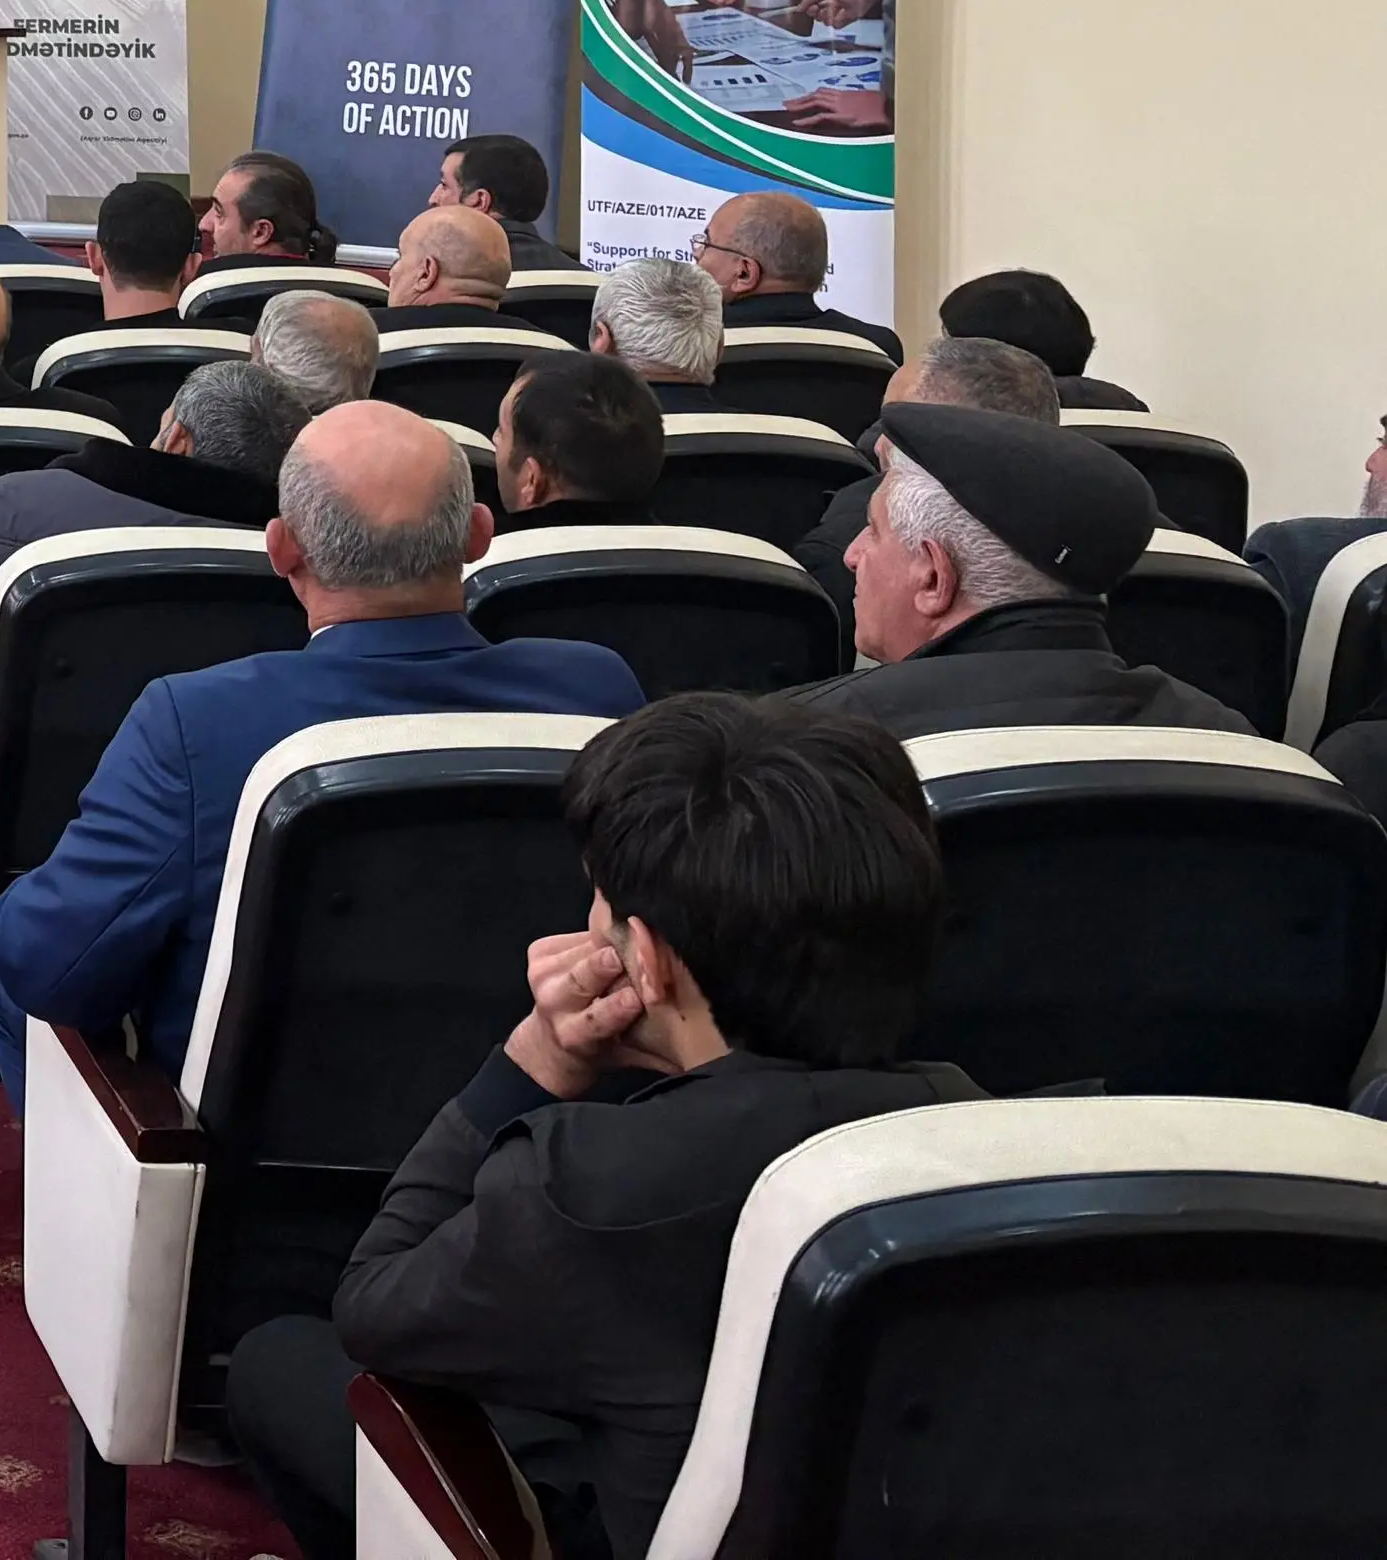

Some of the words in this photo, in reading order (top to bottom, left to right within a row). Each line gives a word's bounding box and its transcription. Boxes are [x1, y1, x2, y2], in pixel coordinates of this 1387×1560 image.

[13, 14, 120, 35] FERMERİN
[7, 38, 156, 58] DMƏTİNDƏYİK
[346, 60, 396, 94] 365
[404, 63, 473, 98] DAYS
[343, 102, 375, 134] OF
[378, 104, 469, 140] ACTION
[587, 200, 707, 221] UTF/AZE/017/AZE
[652, 247, 671, 259] for
